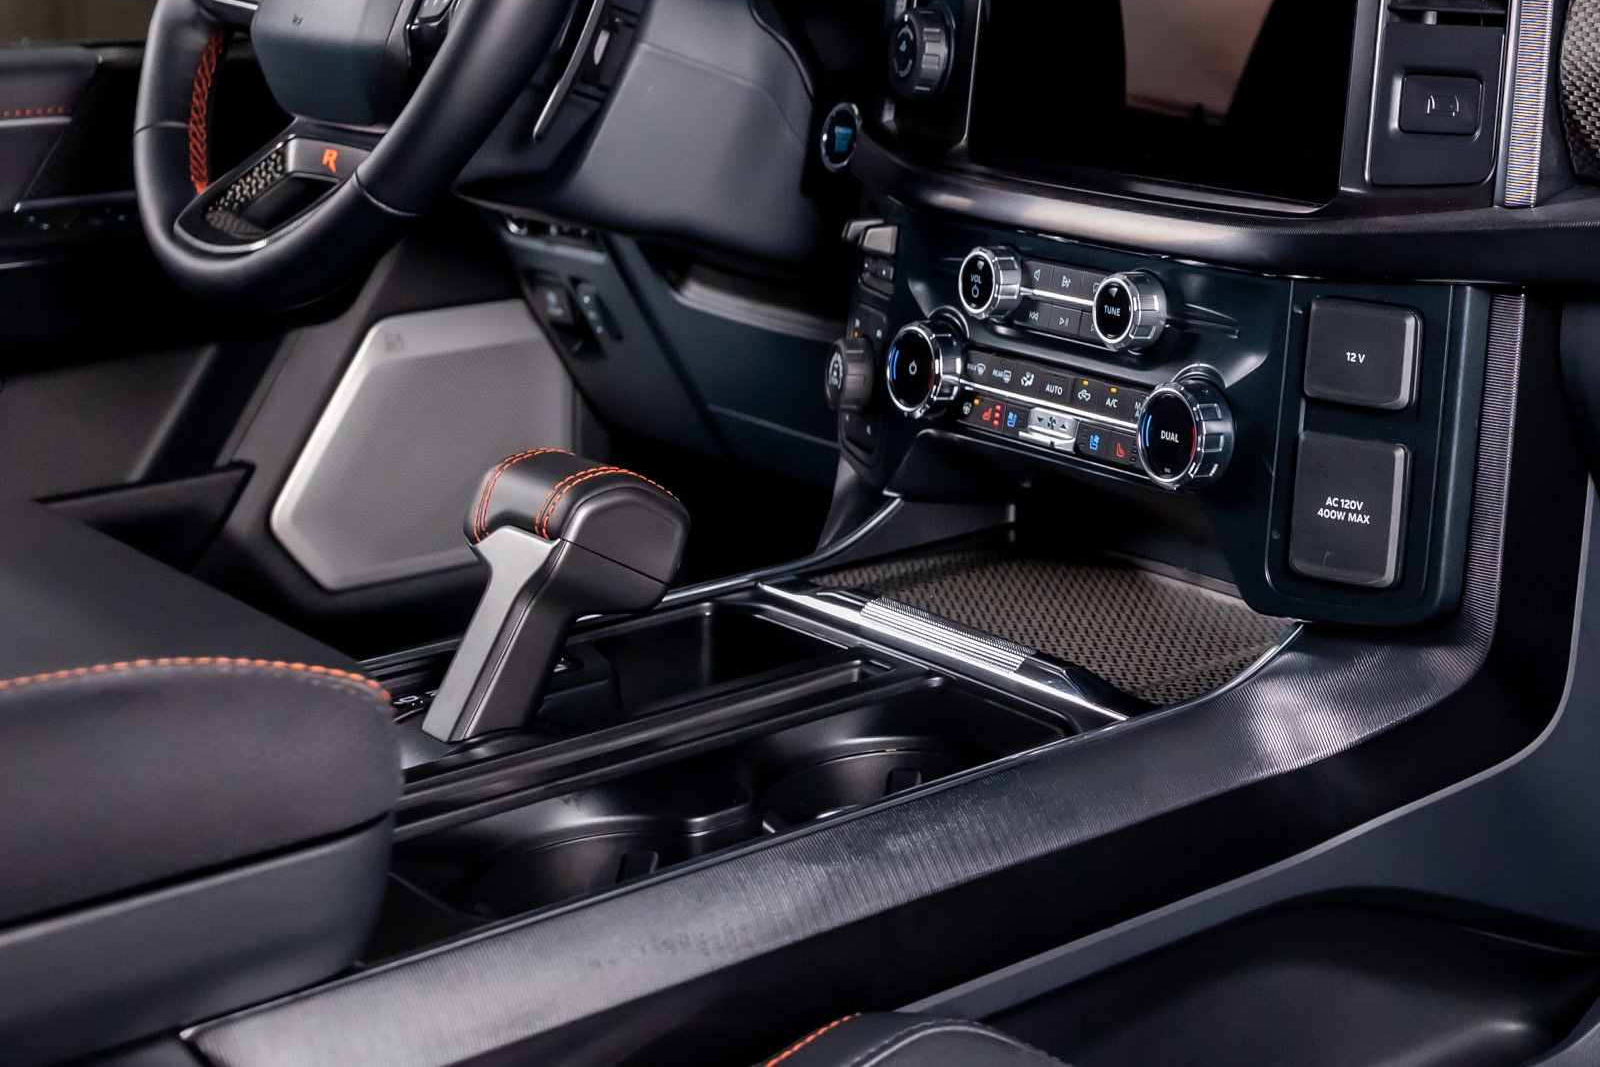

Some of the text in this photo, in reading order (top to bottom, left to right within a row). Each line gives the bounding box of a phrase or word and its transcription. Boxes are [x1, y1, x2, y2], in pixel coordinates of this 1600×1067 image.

[322, 148, 338, 174] R
[970, 274, 982, 284] VOL
[1103, 305, 1121, 317] TUNE
[1346, 351, 1366, 364] 12 V
[1045, 383, 1063, 396] AUTO
[1105, 398, 1119, 409] A/C
[1160, 429, 1180, 444] DUAL
[1325, 496, 1364, 511] AC 120V
[1317, 507, 1370, 524] 400W MAX
